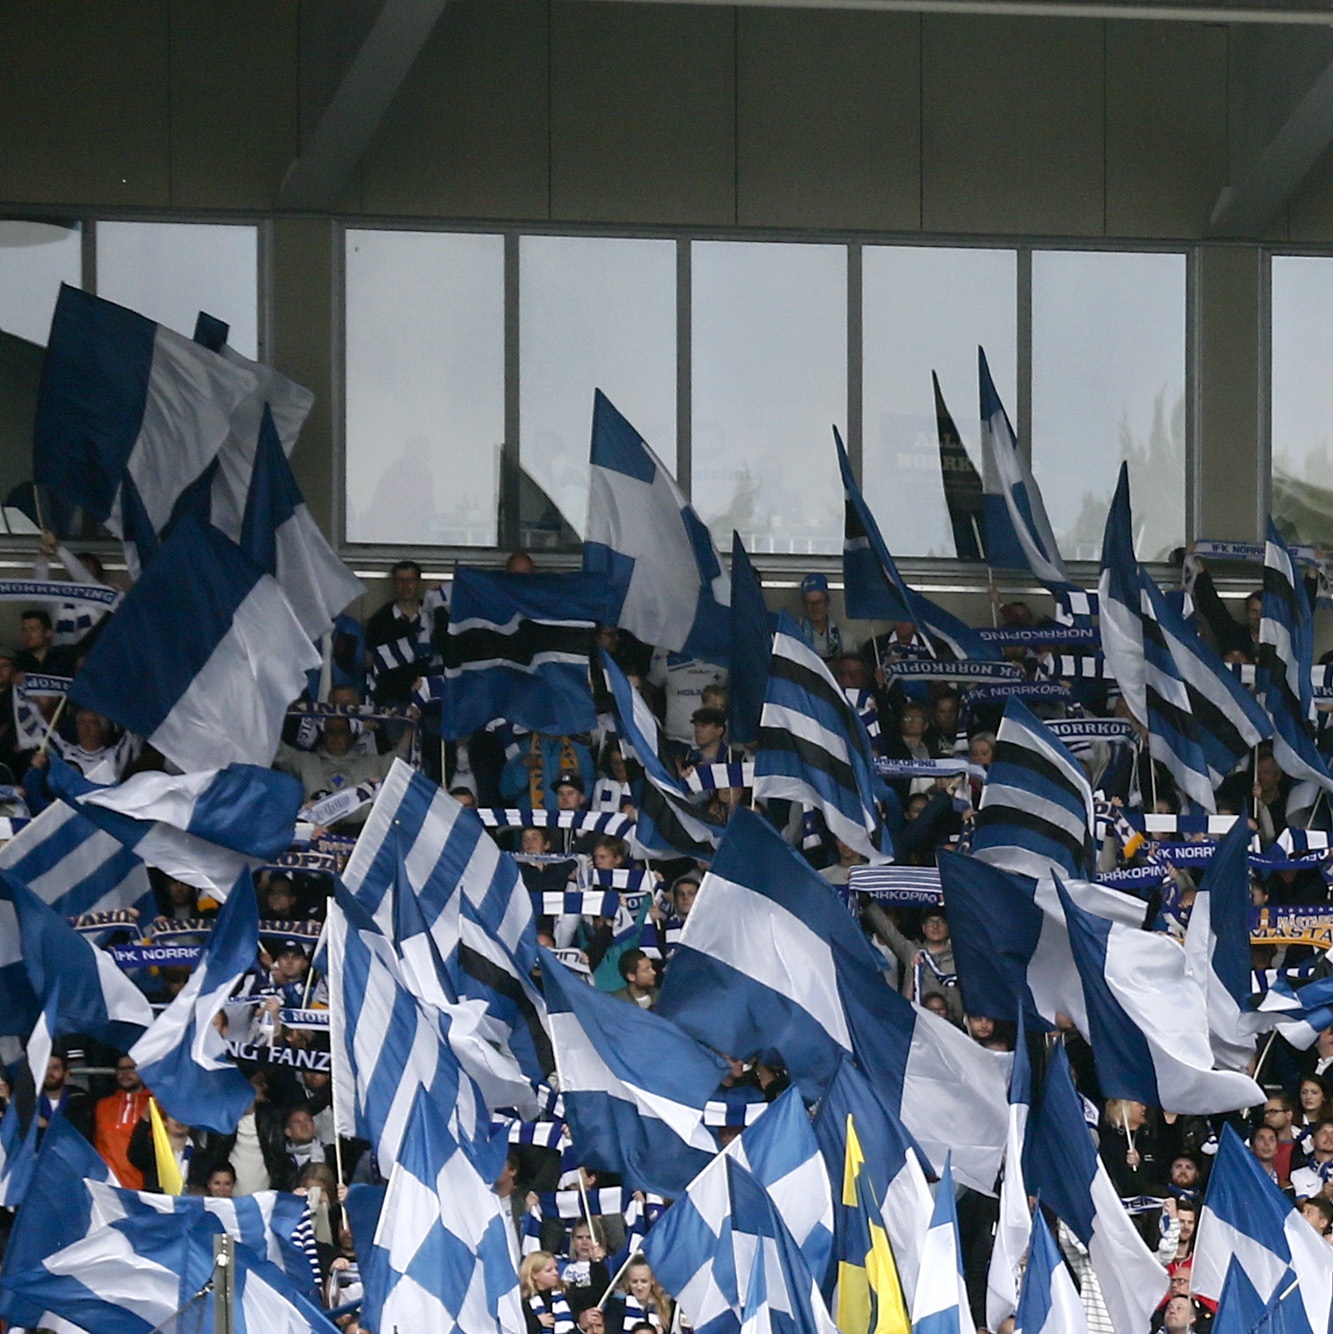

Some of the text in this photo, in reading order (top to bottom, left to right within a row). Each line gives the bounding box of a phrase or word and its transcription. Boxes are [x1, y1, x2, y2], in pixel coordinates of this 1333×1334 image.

[980, 628, 1093, 641] NORRKÖPING
[991, 683, 1071, 696] NORRKÖPIN
[1051, 723, 1132, 735] NORRKÖP
[114, 947, 200, 962] IFK NORRK
[268, 1043, 331, 1072] FANZ
